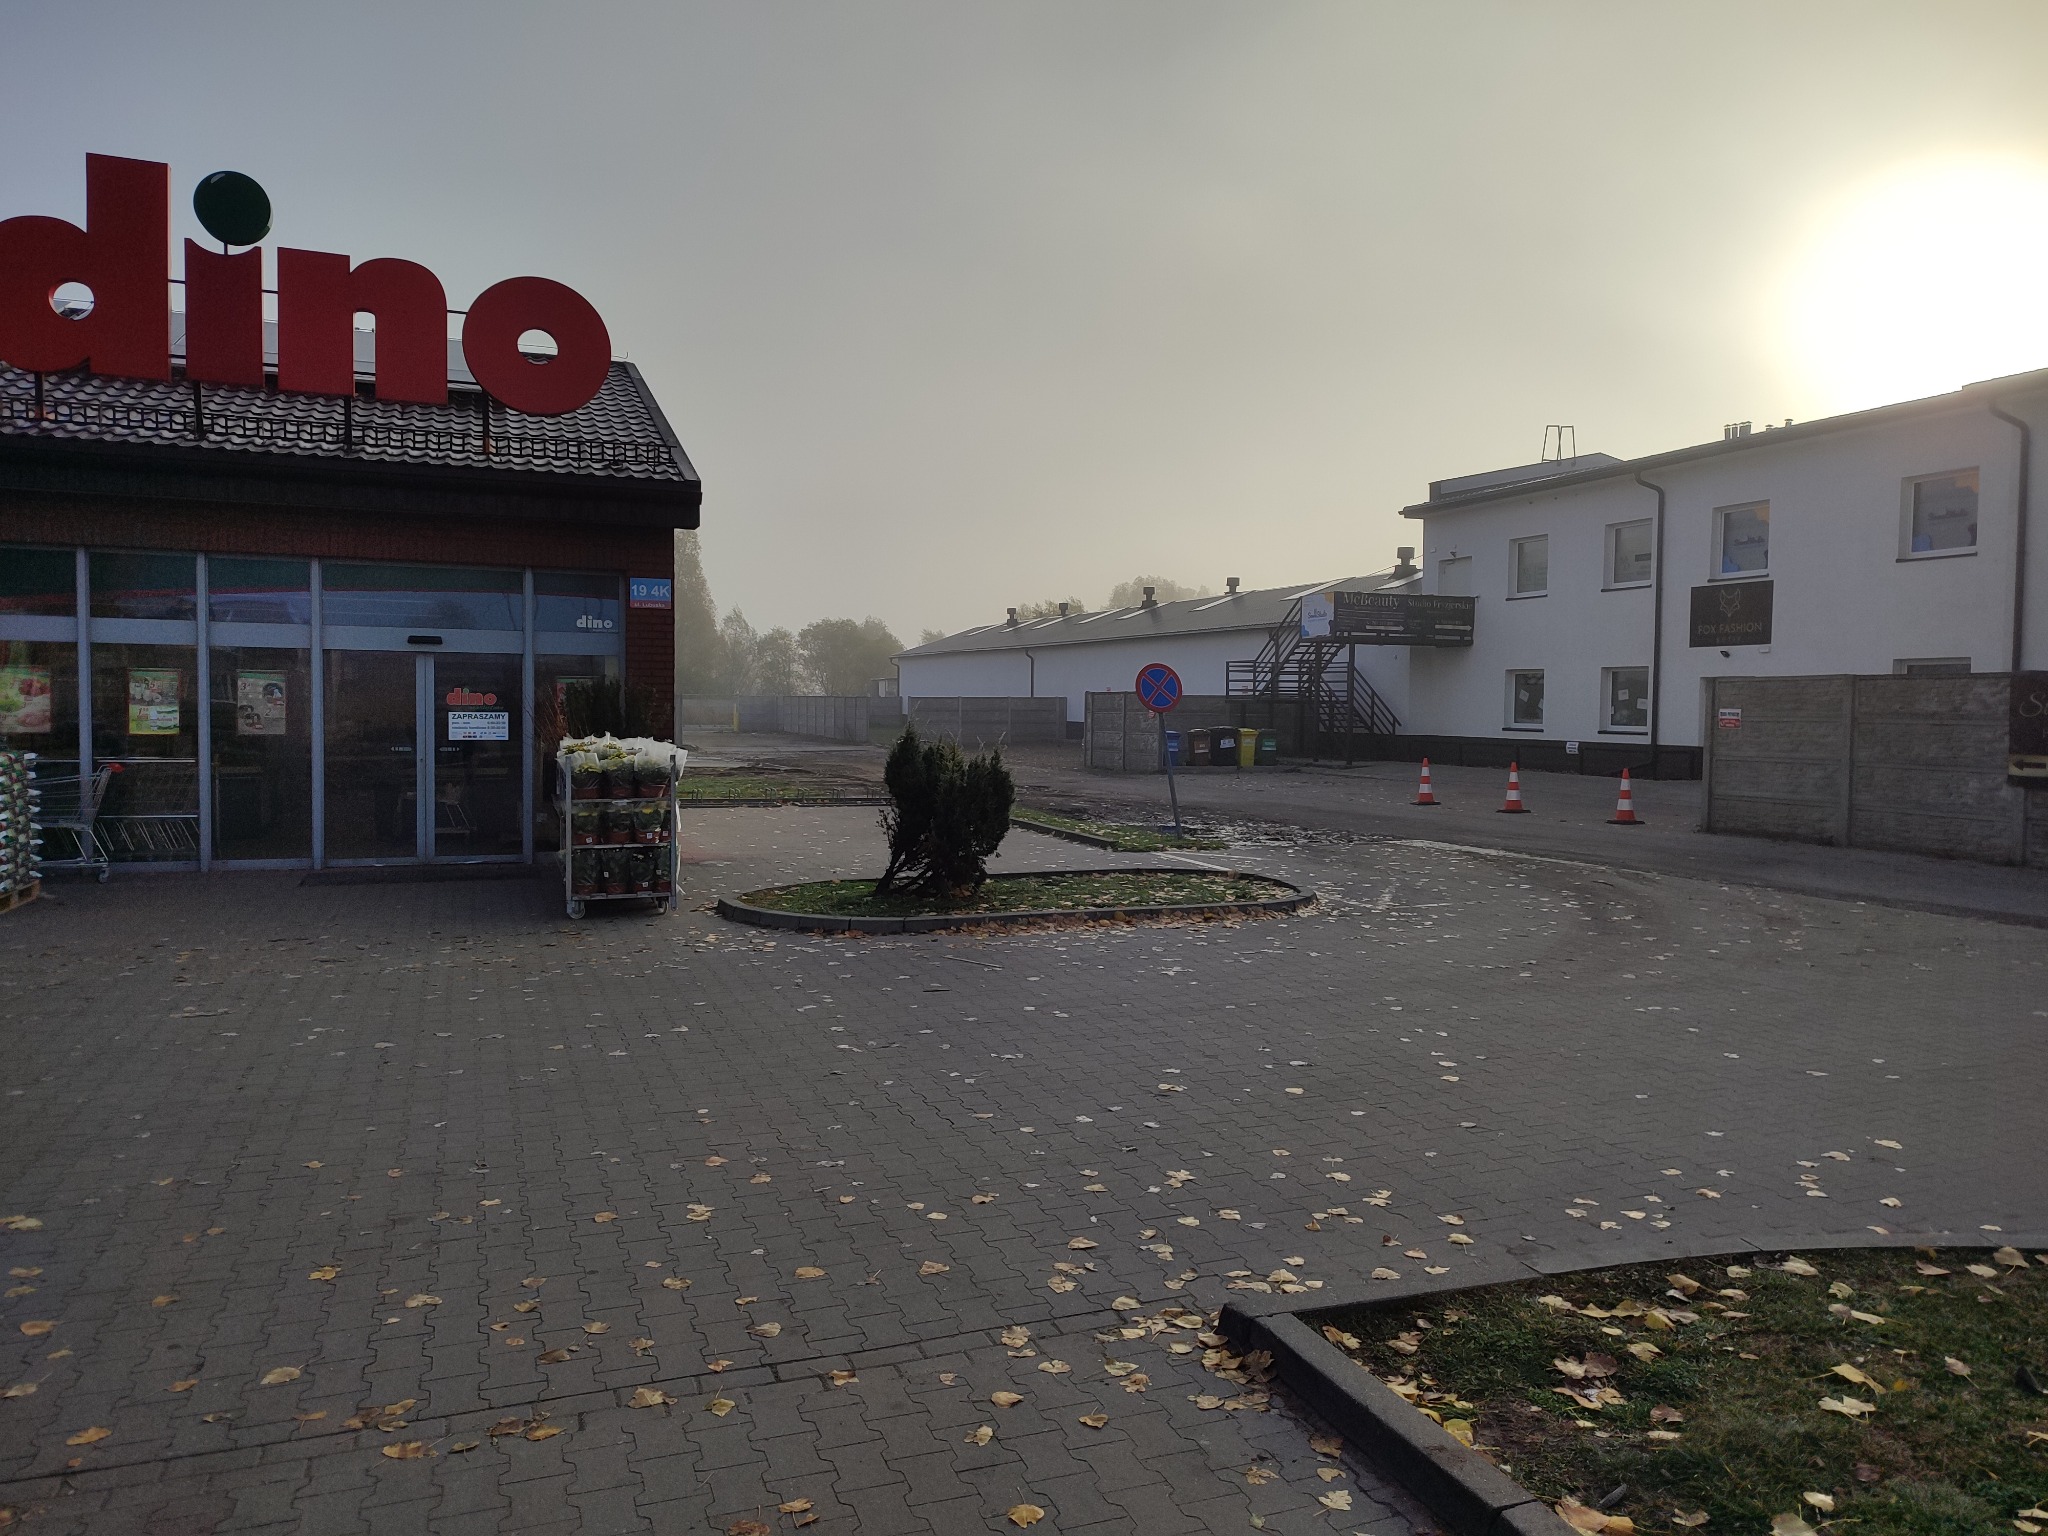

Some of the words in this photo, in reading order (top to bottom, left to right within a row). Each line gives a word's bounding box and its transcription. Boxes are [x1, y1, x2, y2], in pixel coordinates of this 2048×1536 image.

[0, 153, 611, 416] dino
[632, 584, 647, 596] 19
[651, 585, 670, 598] 4K
[1343, 592, 1400, 610] McBeauty
[1407, 598, 1432, 609] Studio
[576, 615, 613, 629] dino
[1698, 624, 1717, 635] FOX
[1719, 622, 1762, 634] FASHION
[446, 687, 498, 706] dino
